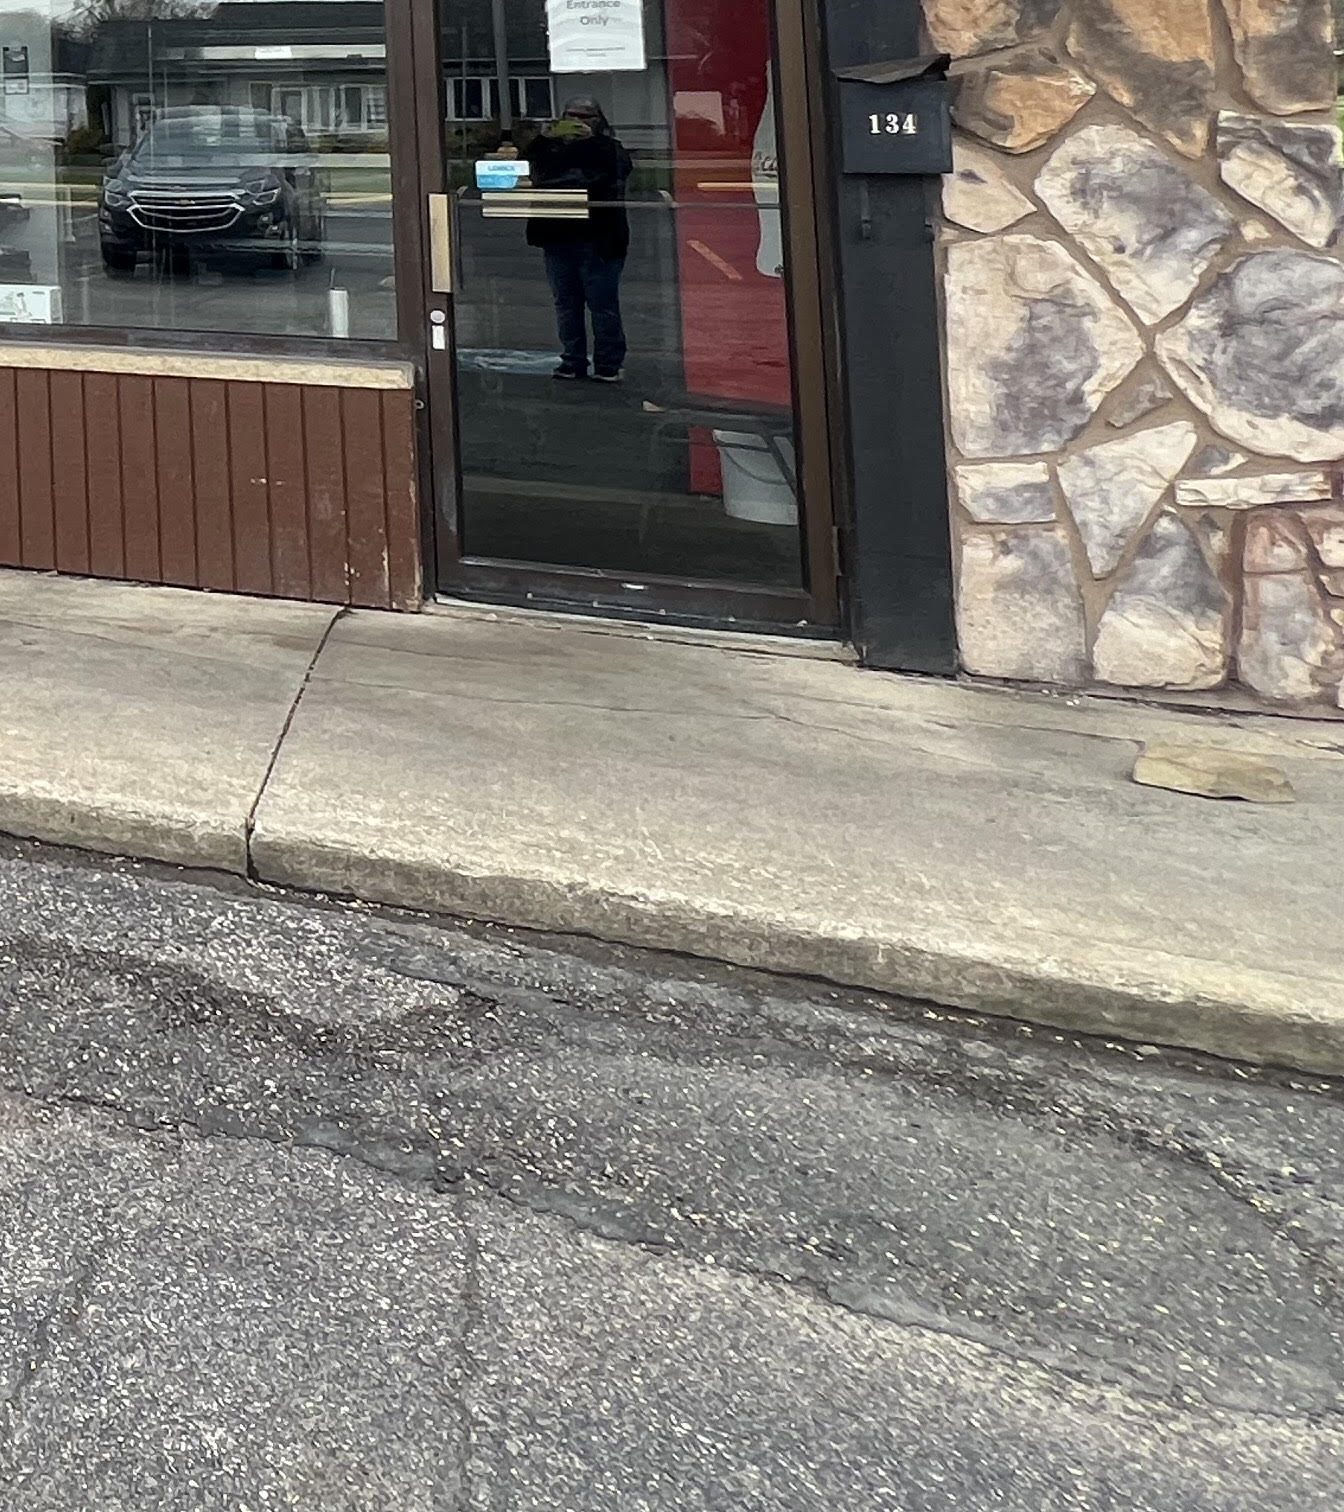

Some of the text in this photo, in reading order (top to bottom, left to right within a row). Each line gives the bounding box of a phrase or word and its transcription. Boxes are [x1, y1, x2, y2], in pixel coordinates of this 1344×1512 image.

[567, 0, 621, 9] Entrance
[580, 15, 610, 26] Only
[868, 113, 918, 135] 134
